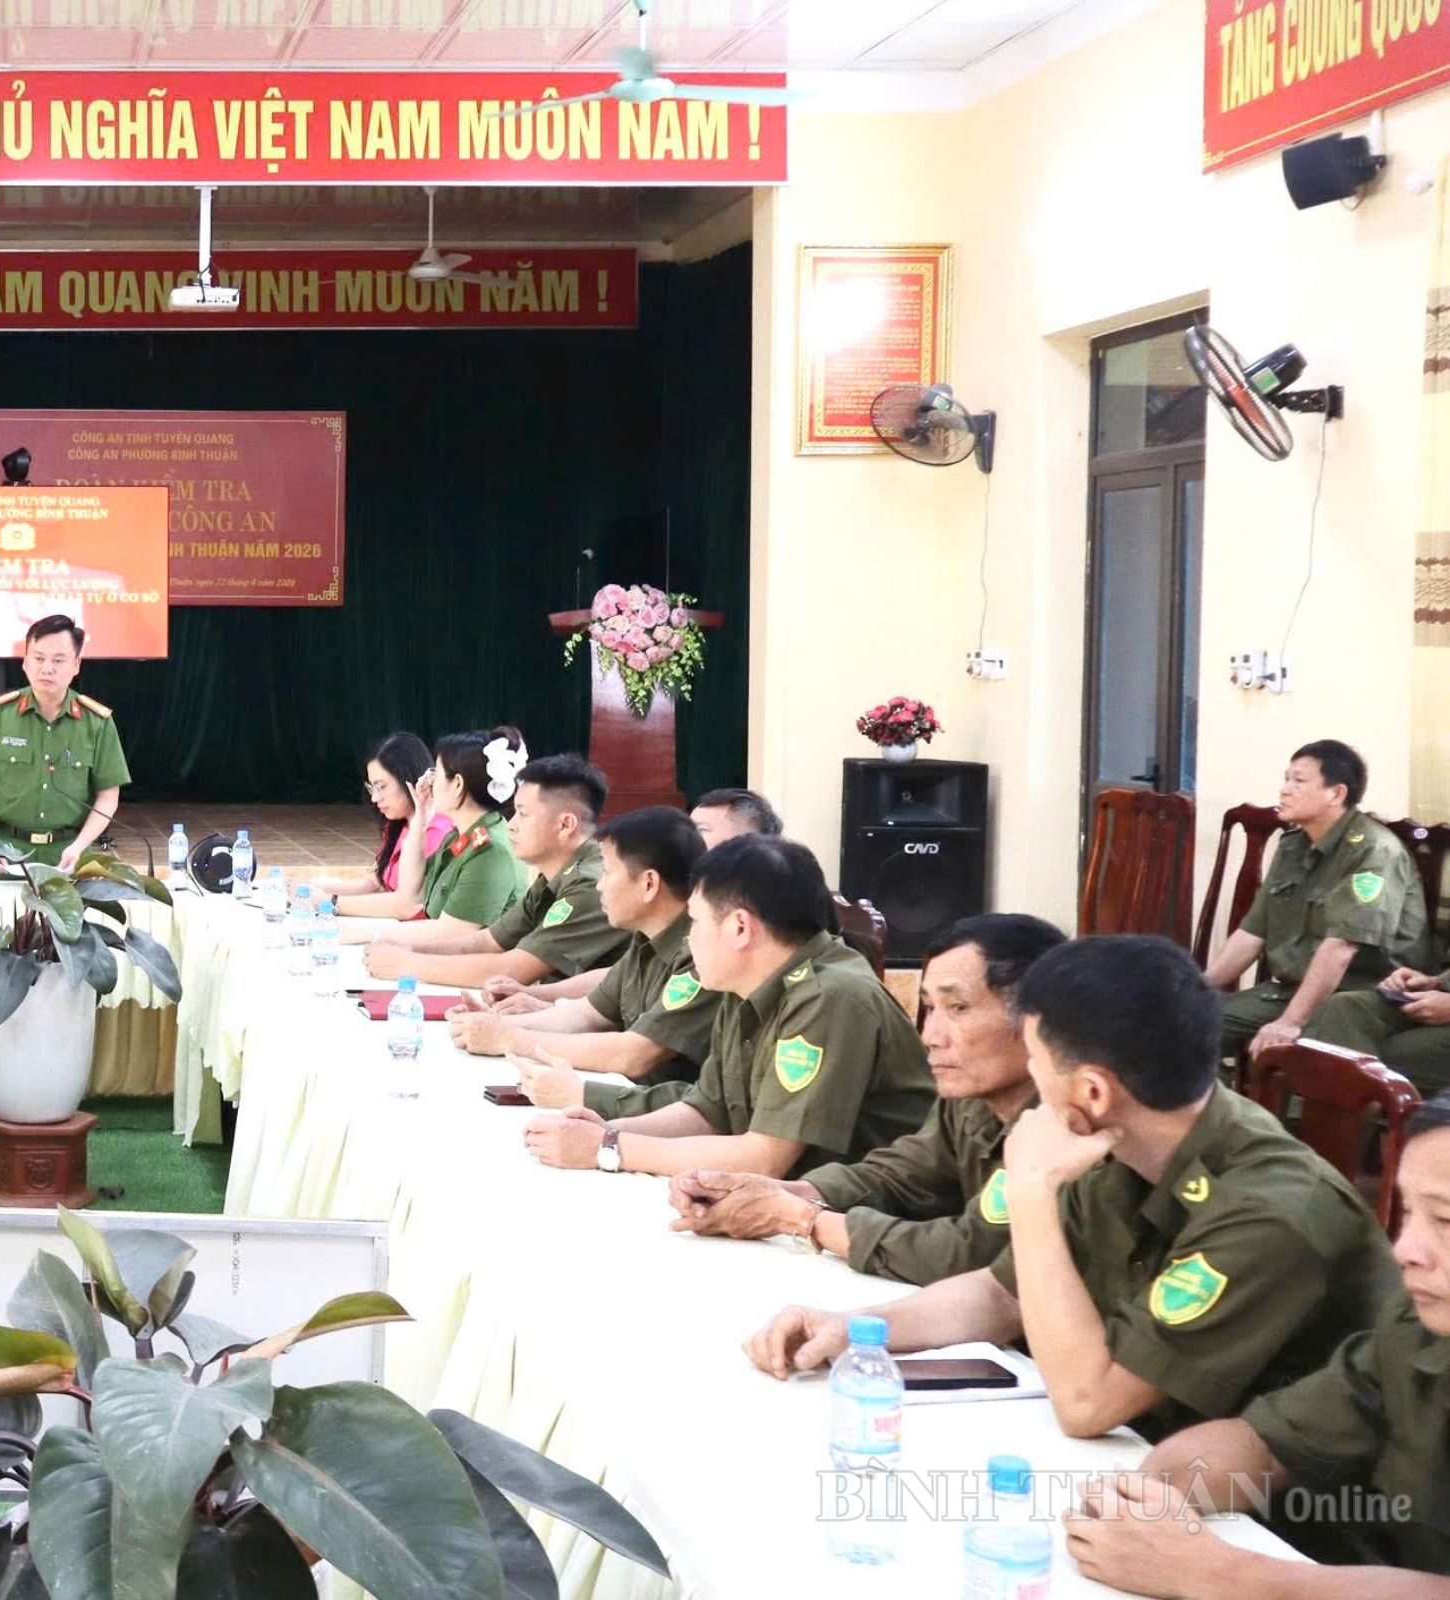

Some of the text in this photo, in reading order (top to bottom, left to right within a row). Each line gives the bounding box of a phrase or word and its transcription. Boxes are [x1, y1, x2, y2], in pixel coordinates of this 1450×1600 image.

[50, 87, 198, 161] NGHĨA
[213, 87, 314, 173] VIỆT
[330, 100, 440, 160] NAM
[458, 87, 601, 160] MUÔN
[218, 270, 319, 312] VINH
[481, 260, 579, 312] NĂM
[597, 270, 608, 312] !
[72, 431, 104, 444] CÔNG
[107, 433, 124, 444] AN
[154, 431, 191, 444] TUYÊN
[194, 433, 235, 446] QUANG
[68, 446, 99, 461] CÔNG
[102, 449, 119, 461] AN
[200, 447, 238, 463] THUẬN
[203, 479, 252, 501] TRA
[18, 493, 57, 507] TUYÊN
[58, 496, 101, 507] QUANG
[67, 506, 109, 521] THUẬN
[170, 505, 276, 532] CÔNG AN
[190, 539, 239, 560] THUẬN
[244, 539, 280, 558] NĂM
[284, 542, 322, 558] 2026
[26, 557, 71, 575] TRA
[904, 843, 939, 854] CAVD
